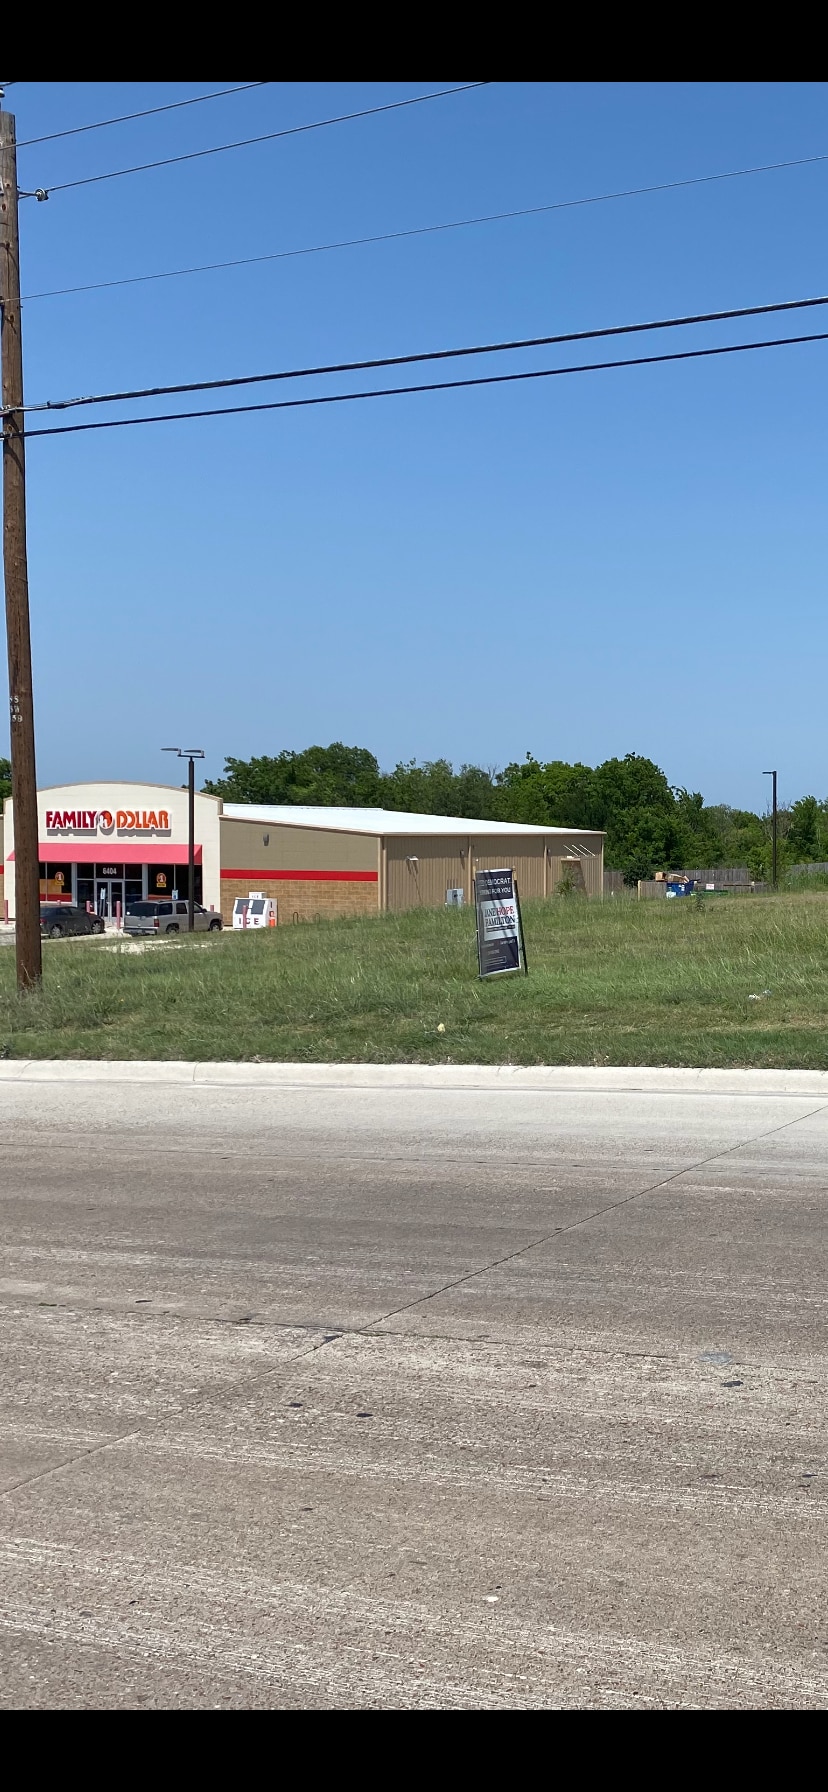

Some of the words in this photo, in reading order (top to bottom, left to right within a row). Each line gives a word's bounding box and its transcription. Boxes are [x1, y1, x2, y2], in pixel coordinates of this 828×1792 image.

[45, 810, 97, 829] FAMILY
[116, 810, 169, 829] DOLLAR
[496, 905, 515, 915] HOPE
